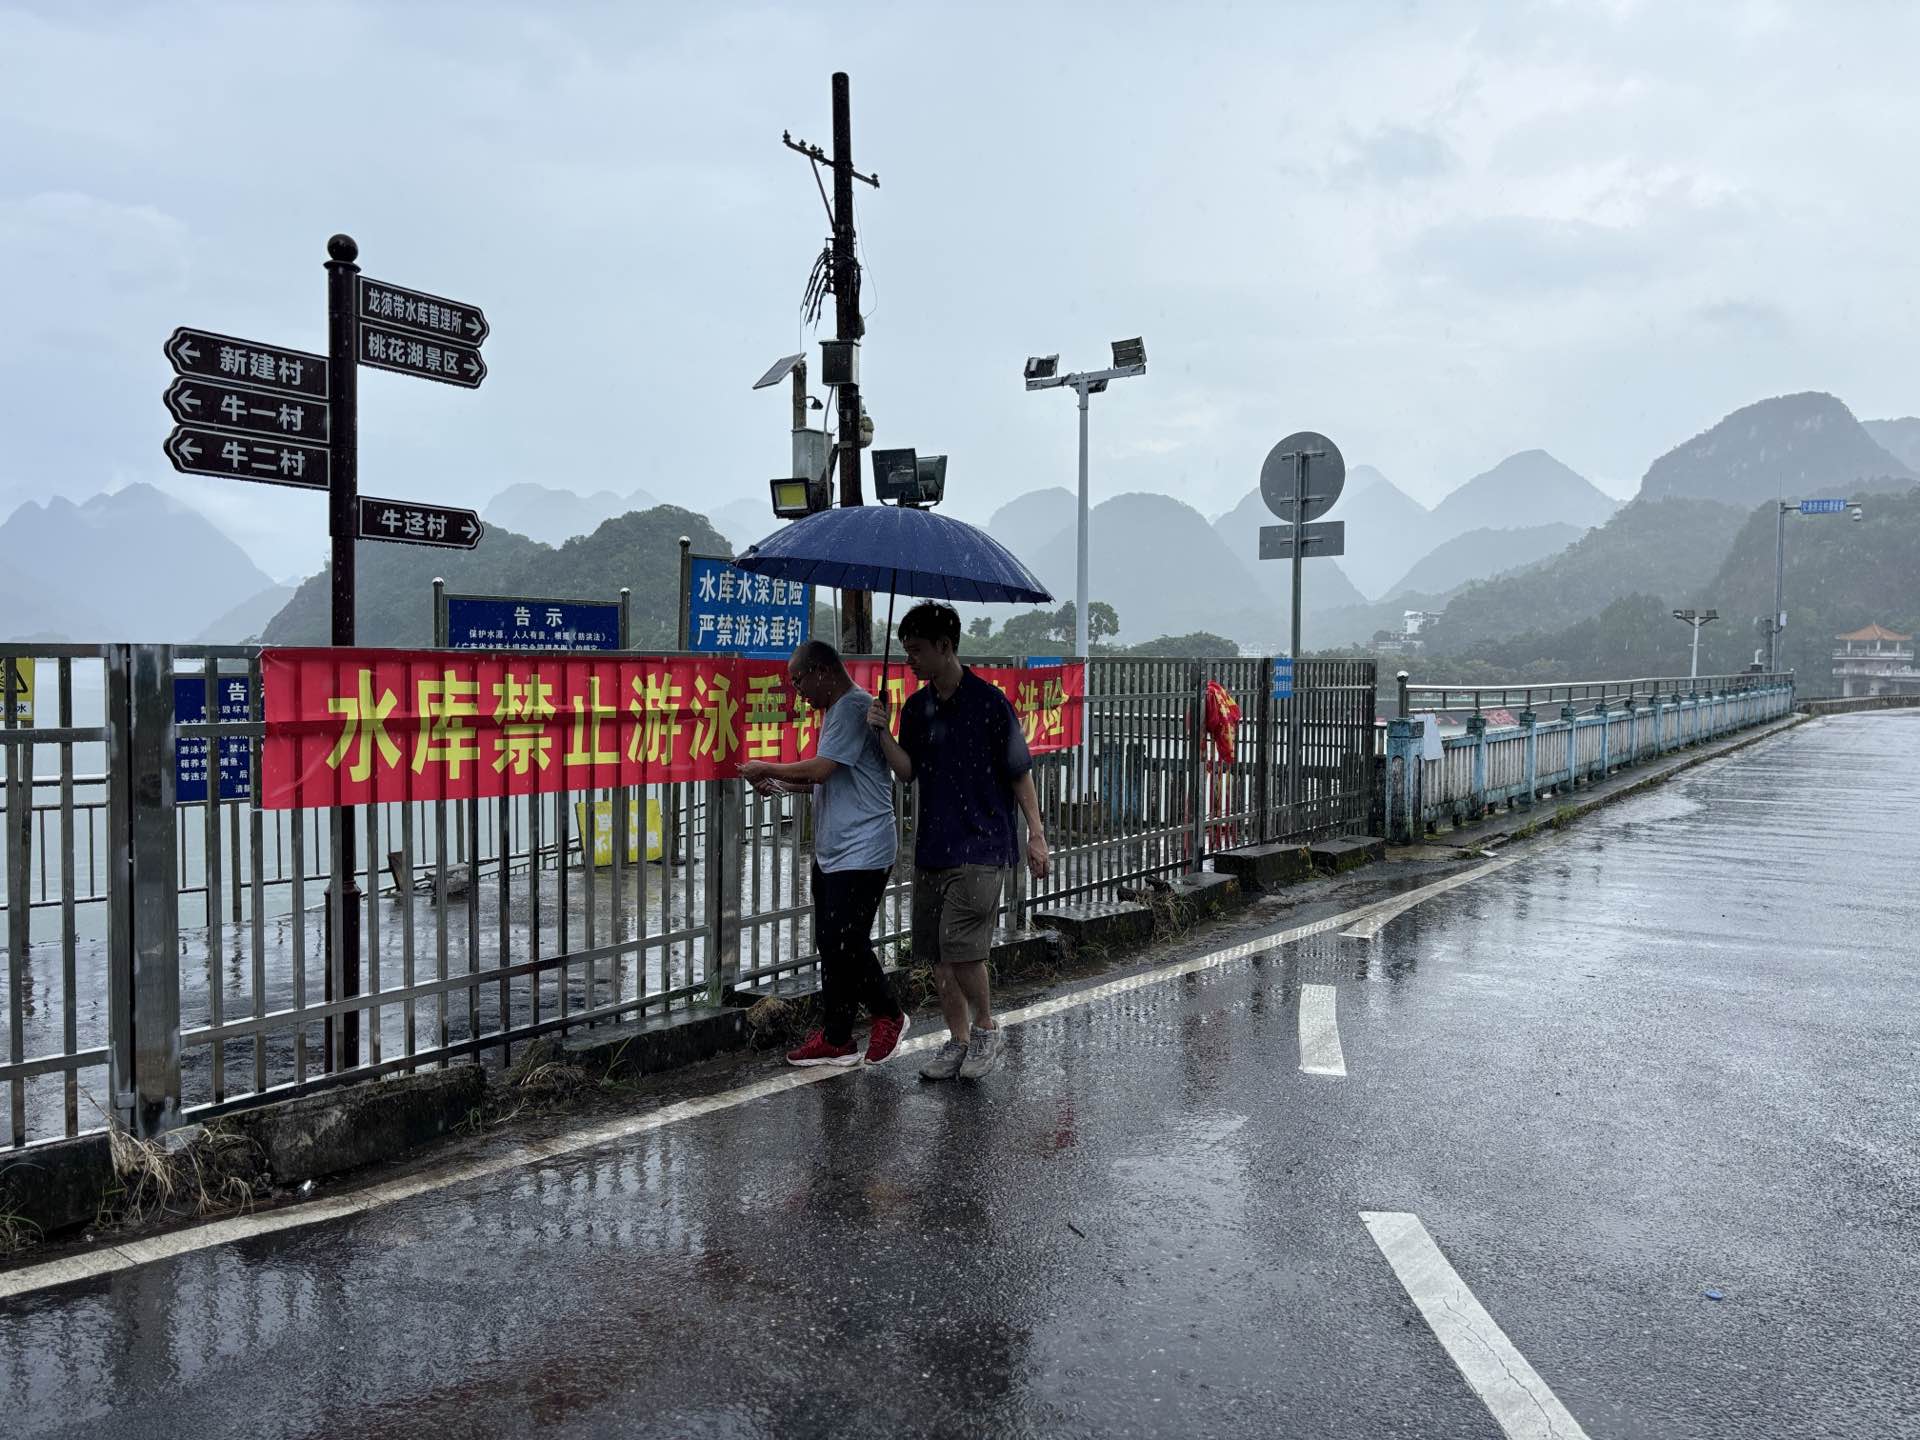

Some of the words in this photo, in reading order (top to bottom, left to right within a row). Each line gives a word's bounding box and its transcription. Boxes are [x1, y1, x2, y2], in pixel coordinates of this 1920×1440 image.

[368, 289, 463, 335] 龙须带水库管理所
[220, 345, 304, 386] 新建村
[368, 334, 459, 374] 桃花湖景区
[220, 395, 304, 431] 牛一村
[221, 441, 306, 477] 牛二村
[698, 569, 804, 606] 水库水深危险
[514, 606, 563, 627] 告示
[697, 614, 802, 647] 严禁游泳垂钓
